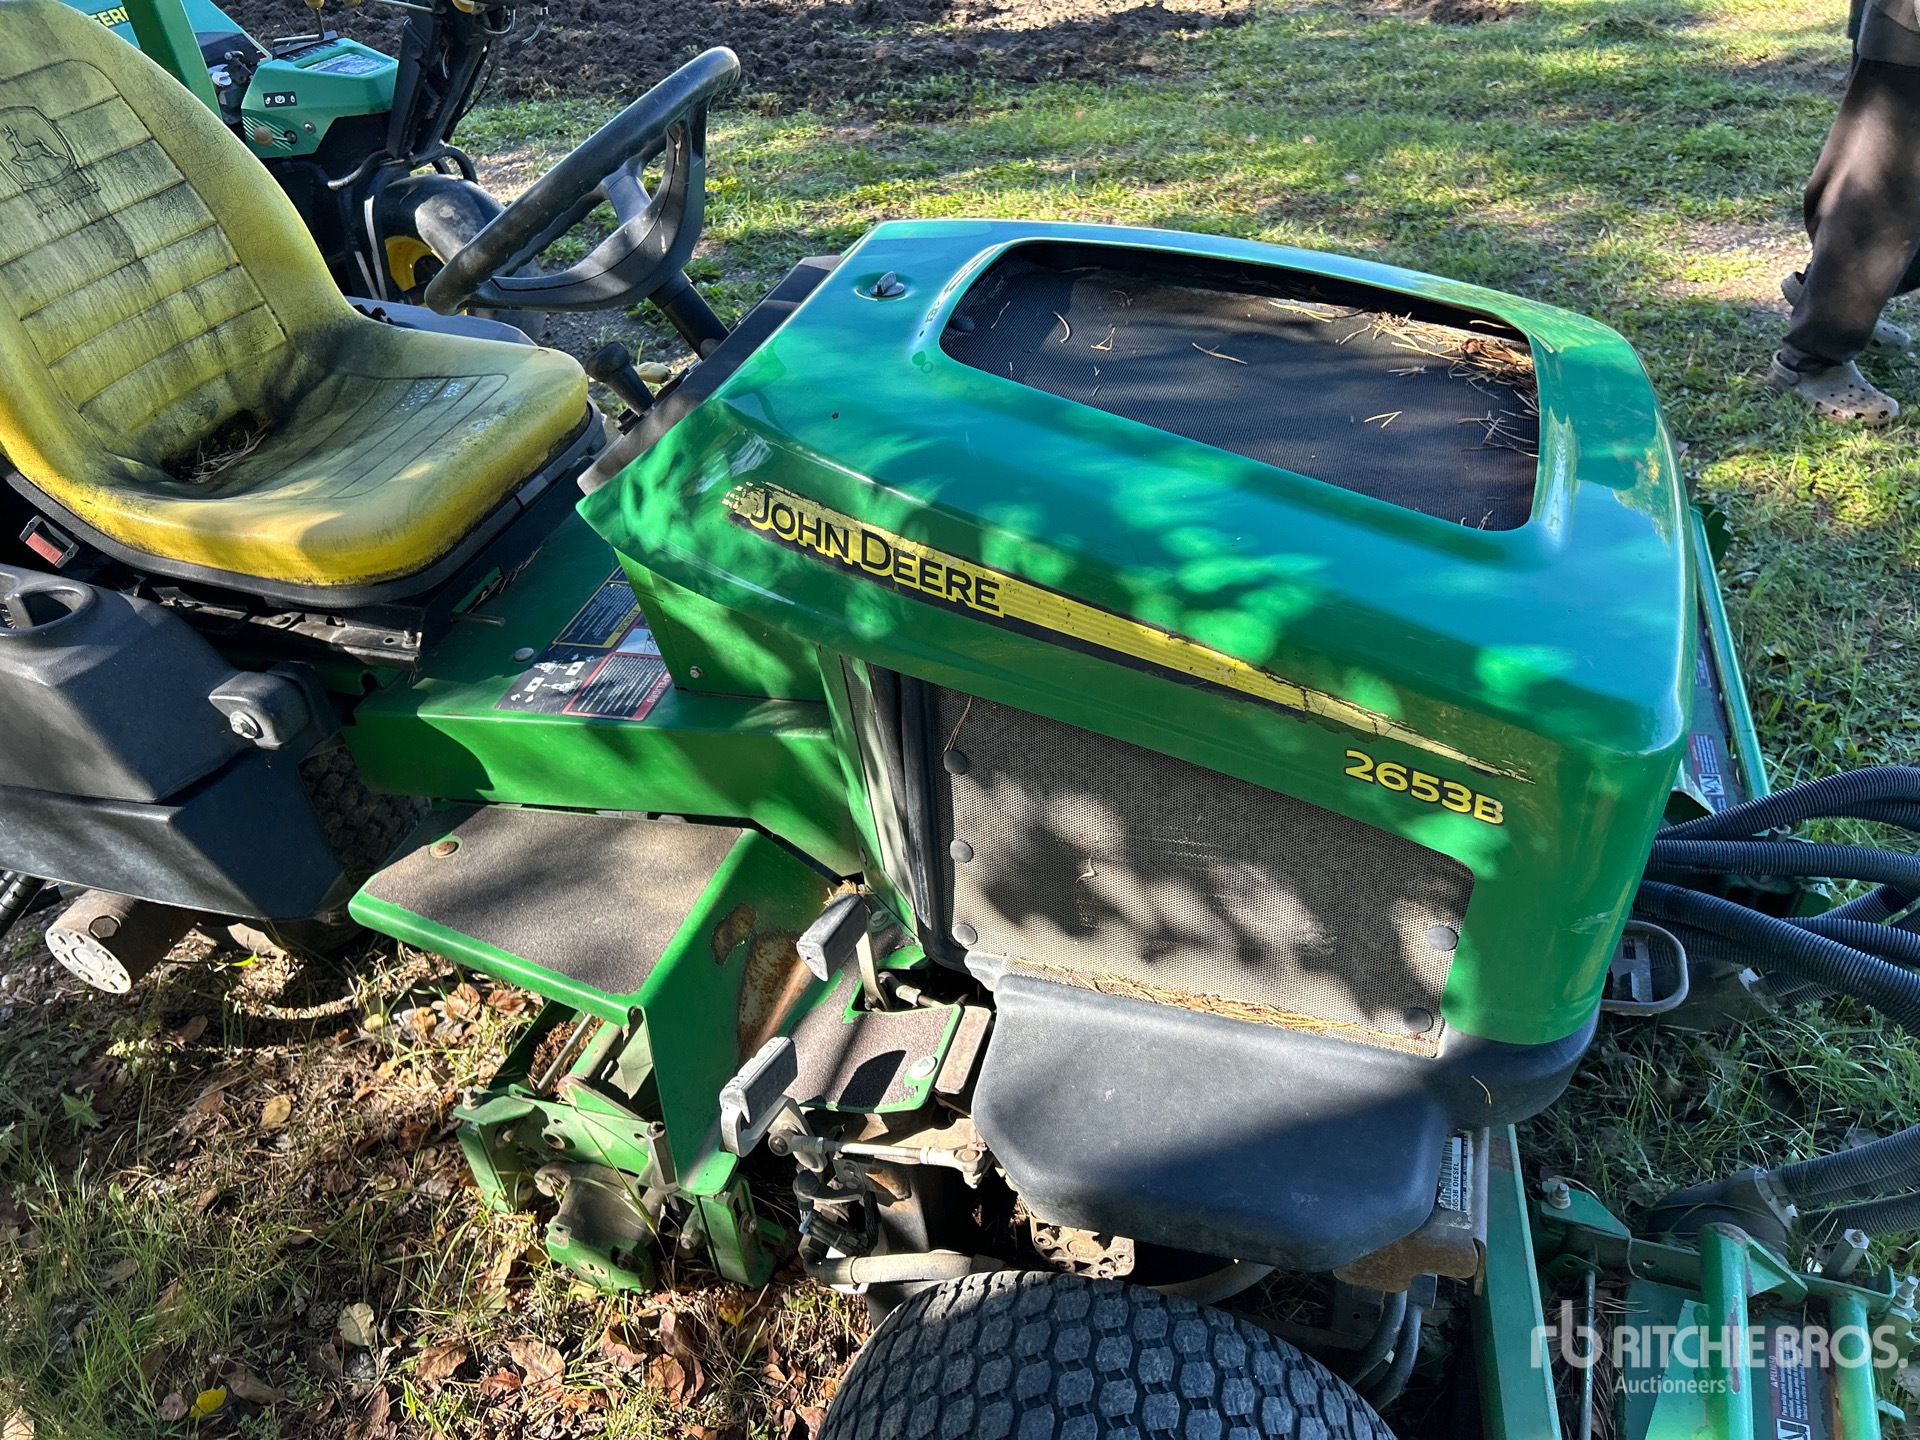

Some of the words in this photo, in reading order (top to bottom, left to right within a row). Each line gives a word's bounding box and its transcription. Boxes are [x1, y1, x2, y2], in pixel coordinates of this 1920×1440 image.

[751, 490, 853, 562] JOHN
[861, 528, 1003, 616] DEERE
[1345, 749, 1504, 824] 2653B
